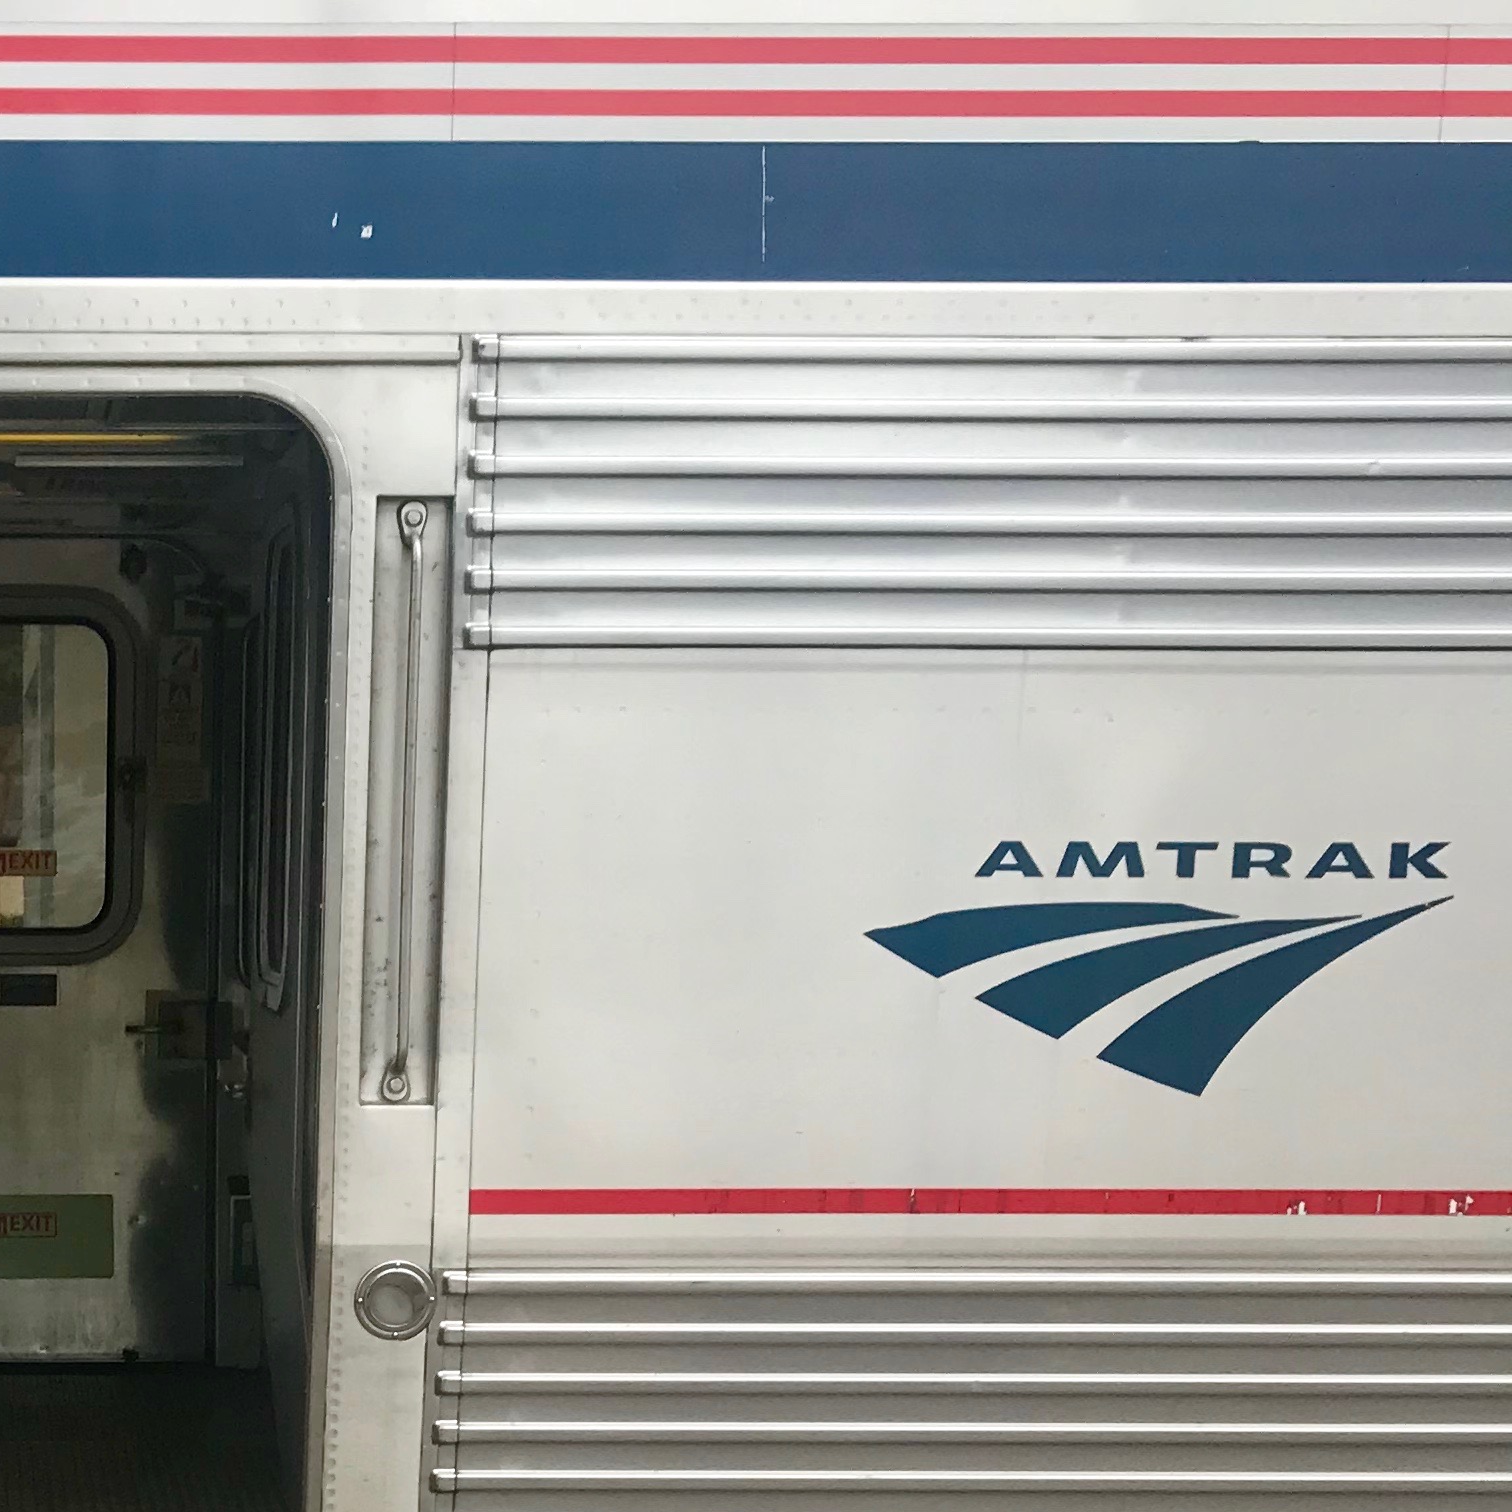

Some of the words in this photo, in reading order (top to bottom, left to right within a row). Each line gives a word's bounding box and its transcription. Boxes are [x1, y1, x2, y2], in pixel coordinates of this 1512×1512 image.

[9, 851, 52, 869] EXIT
[974, 840, 1451, 880] AMTRAK
[10, 1214, 53, 1231] EXIT
